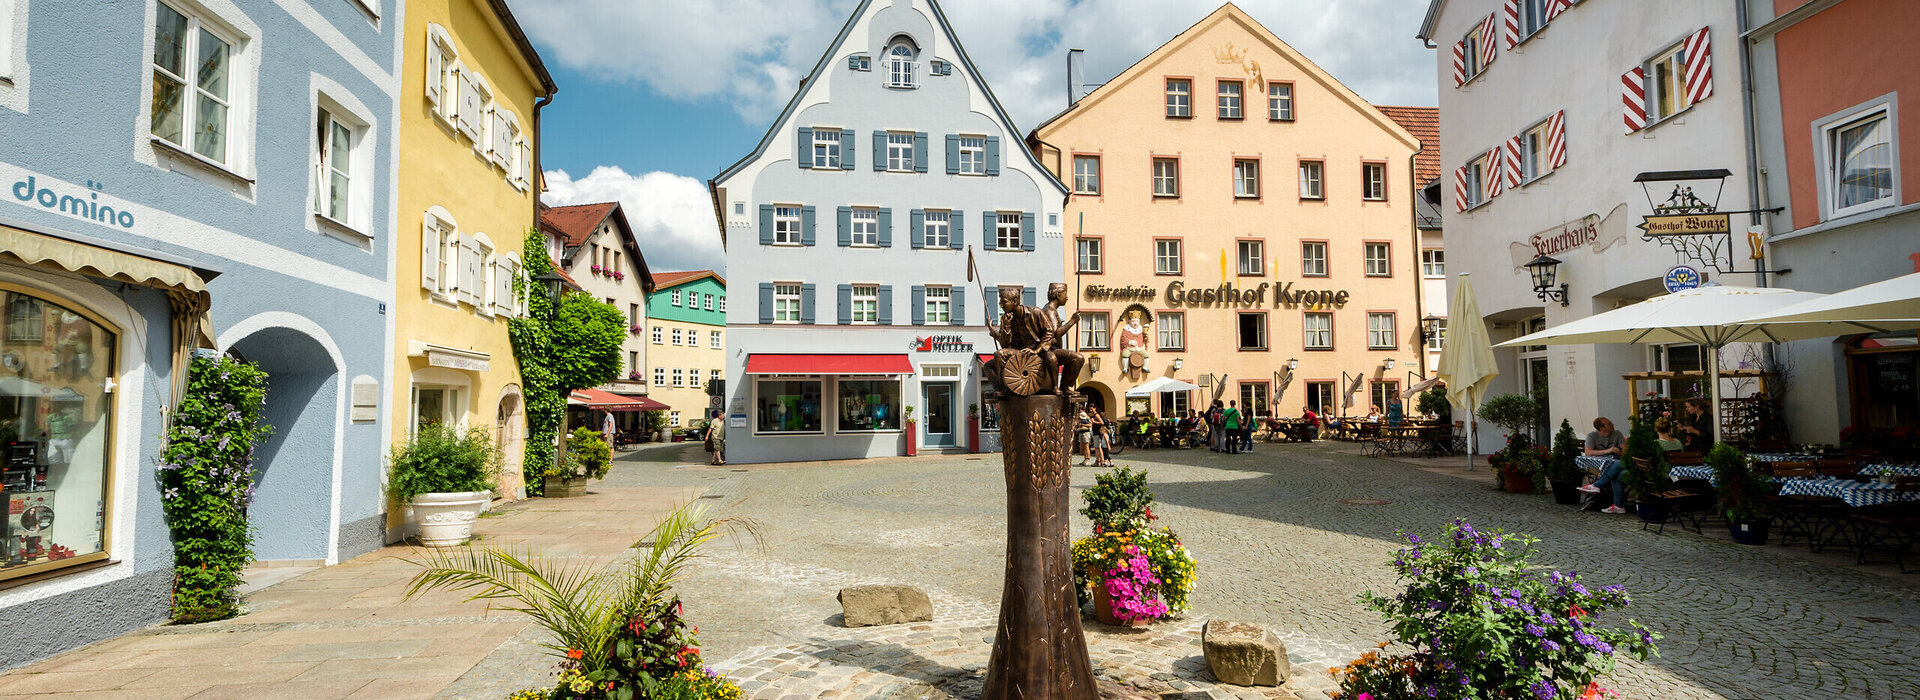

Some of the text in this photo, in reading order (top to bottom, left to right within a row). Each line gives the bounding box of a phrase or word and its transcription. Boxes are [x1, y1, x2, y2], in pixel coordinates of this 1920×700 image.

[1649, 217, 1725, 231] Gasthof Woaze
[1532, 223, 1597, 259] Feuerhaus
[1167, 280, 1350, 304] Gasthof Krone
[932, 335, 963, 343] OPTIK
[932, 342, 974, 352] MÜLLER
